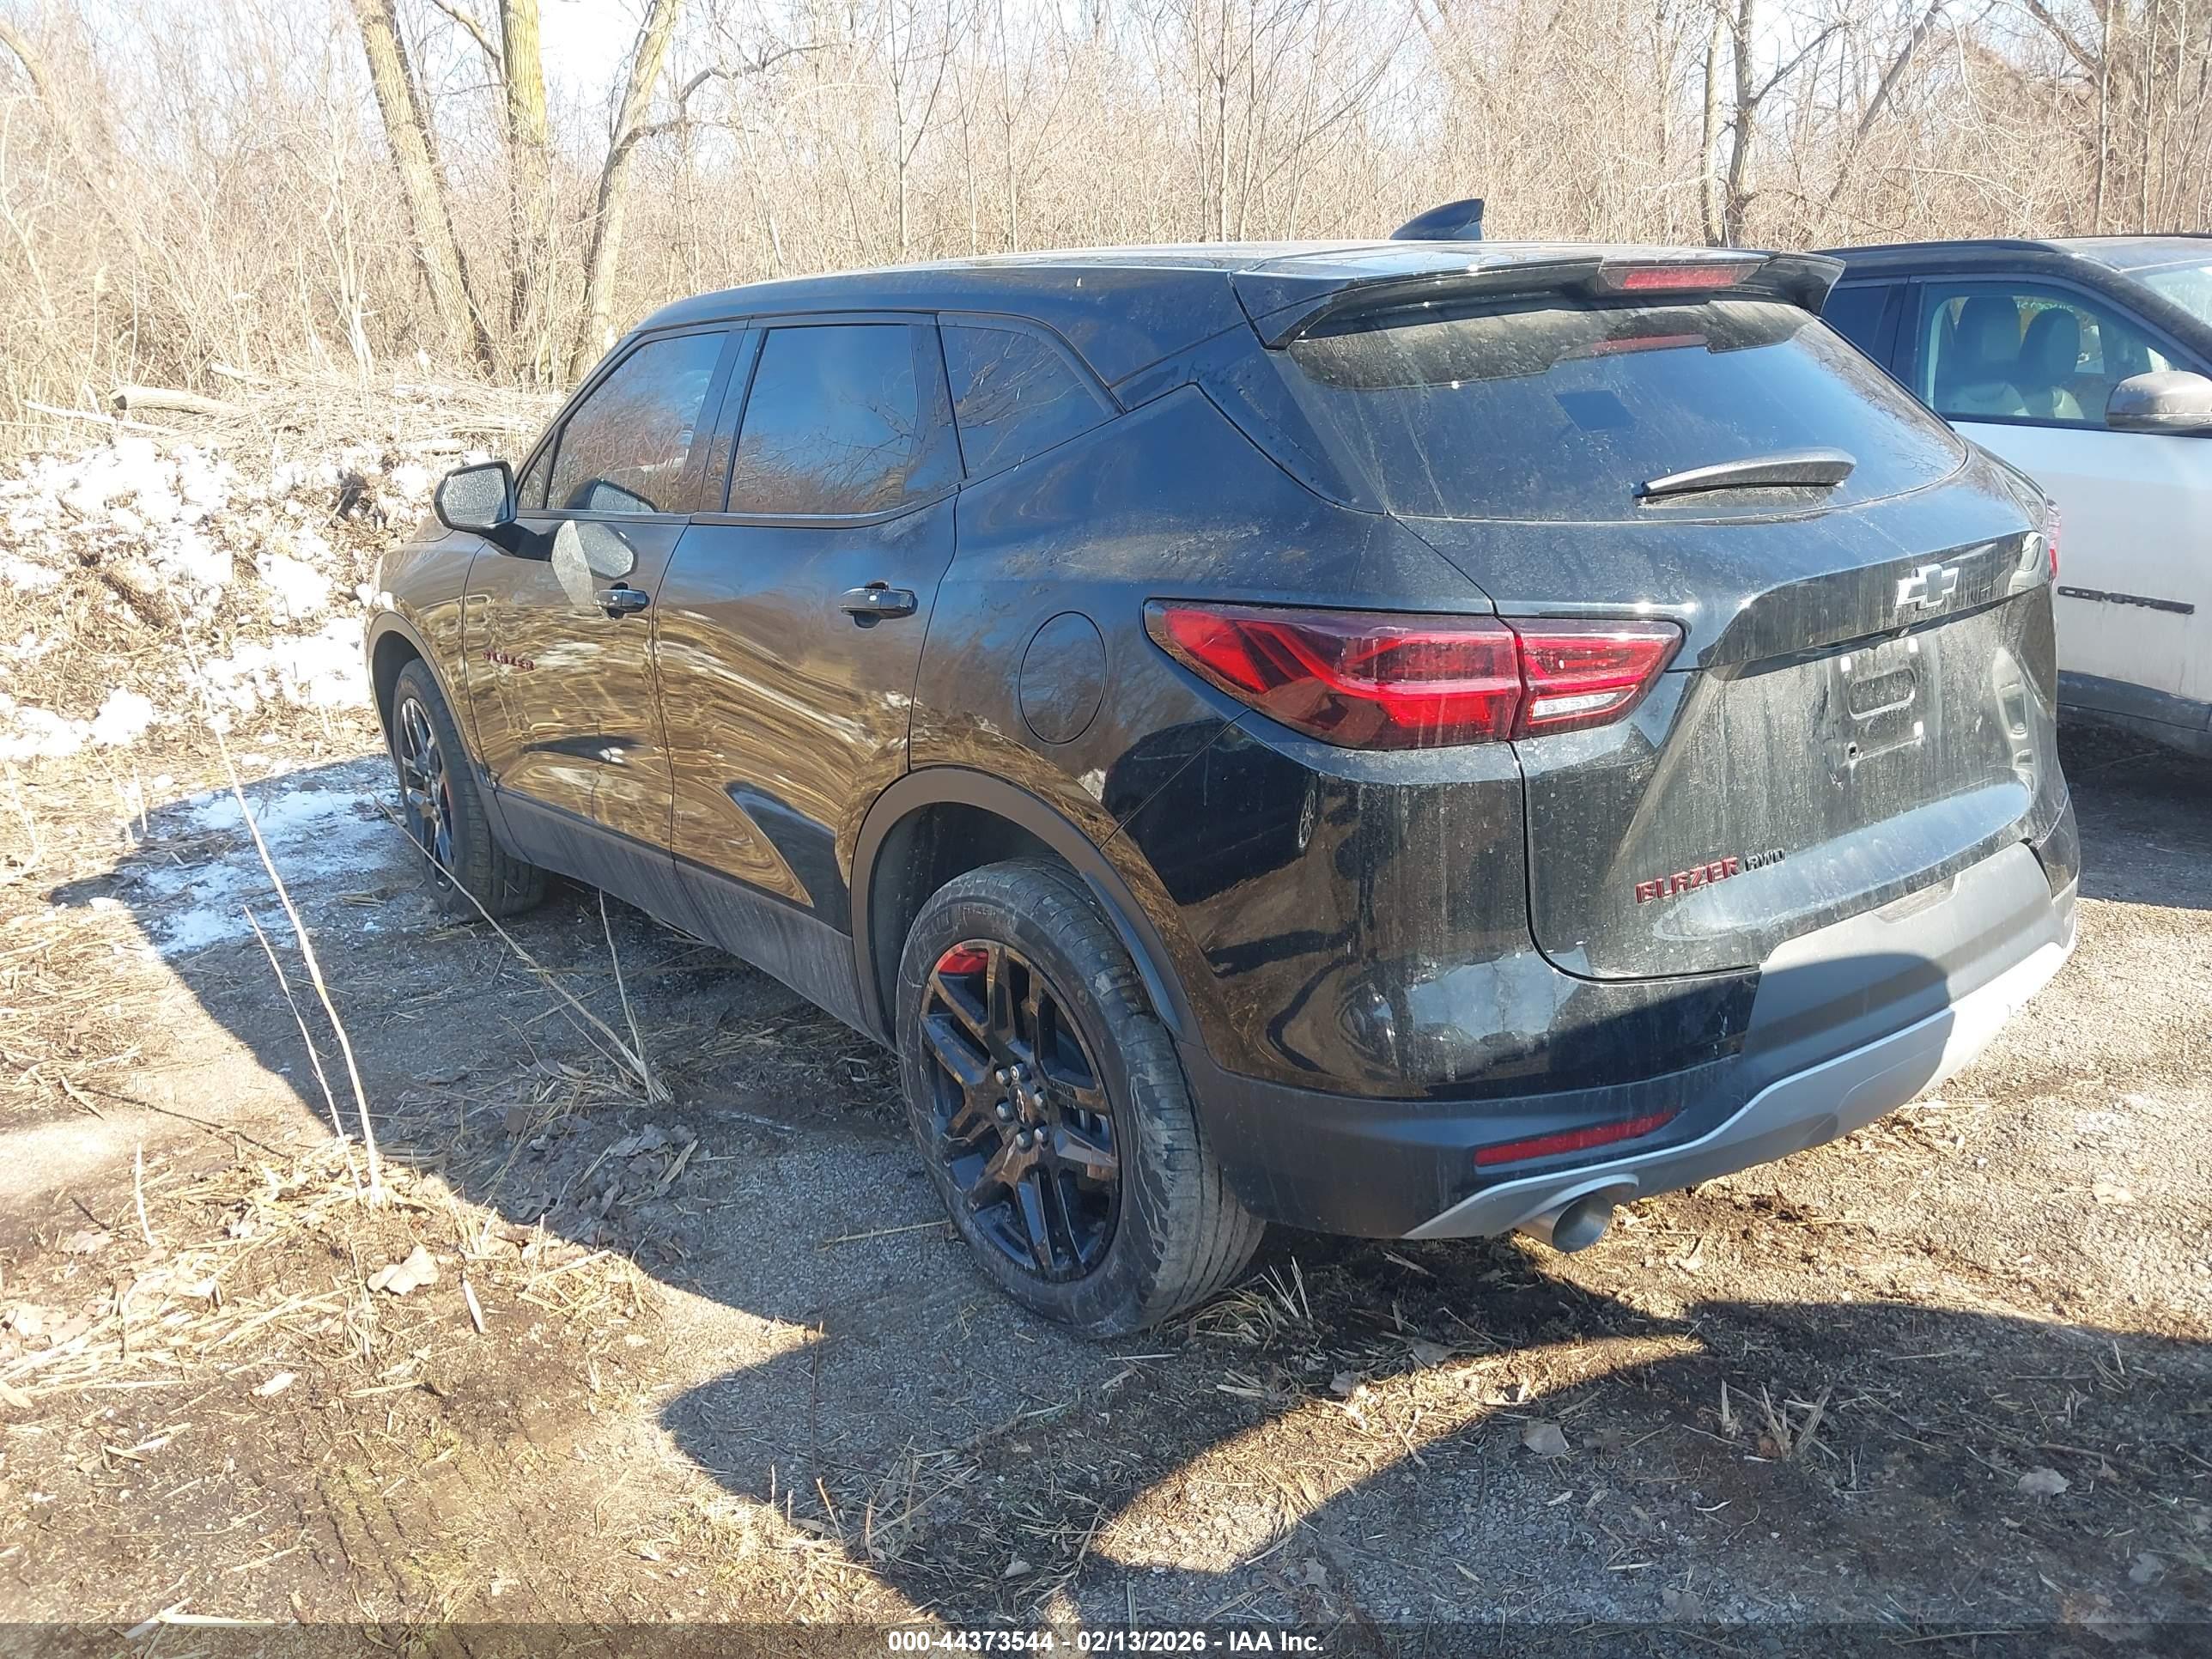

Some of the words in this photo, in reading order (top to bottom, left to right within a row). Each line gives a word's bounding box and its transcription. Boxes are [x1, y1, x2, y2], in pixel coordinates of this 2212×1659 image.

[2057, 586, 2195, 615] COMPA
[482, 649, 536, 671] BLAZER
[1635, 856, 1741, 903] BLAZER
